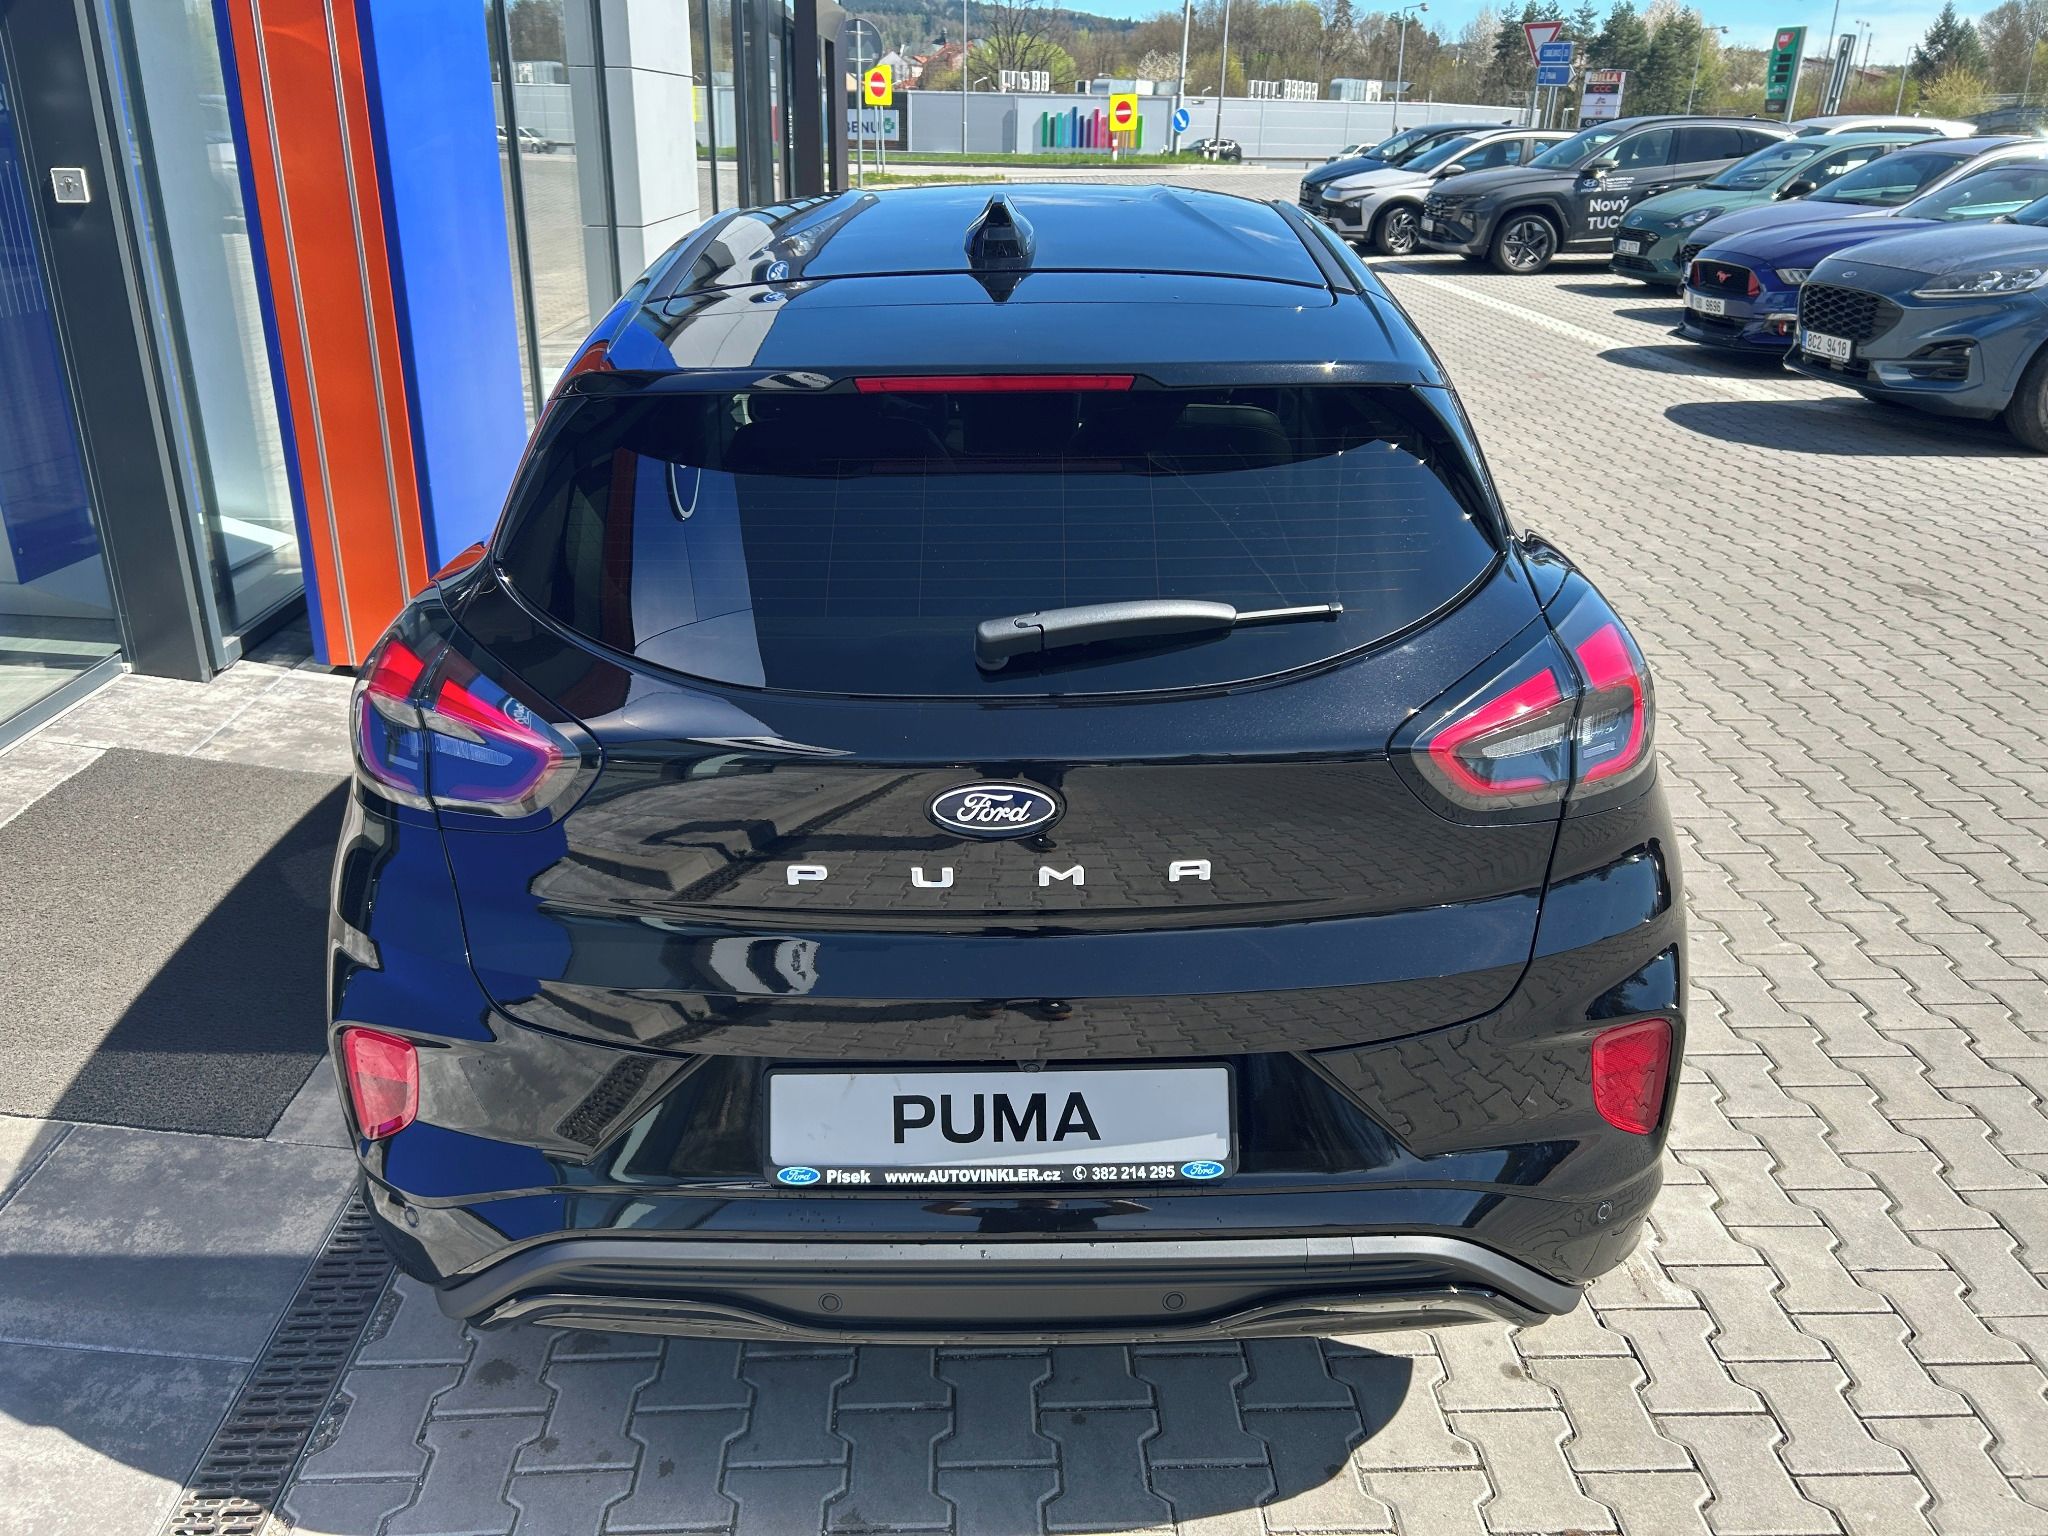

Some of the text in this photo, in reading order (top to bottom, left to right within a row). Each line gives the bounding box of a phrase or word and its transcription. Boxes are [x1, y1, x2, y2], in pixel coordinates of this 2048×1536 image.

[1593, 85, 1612, 93] CCC
[1589, 195, 1630, 213] Nový
[1587, 215, 1622, 230] TUC
[1807, 333, 1847, 357] 8C2 9418
[957, 792, 1031, 823] Ford
[786, 858, 1212, 888] PUMA
[893, 1091, 1101, 1144] PUMA
[826, 1169, 871, 1184] Písek
[885, 1168, 1061, 1183] www.AUTOVINKLER.cz
[1092, 1165, 1118, 1180] 382
[1121, 1166, 1146, 1180] 214
[1150, 1165, 1175, 1178] 295
